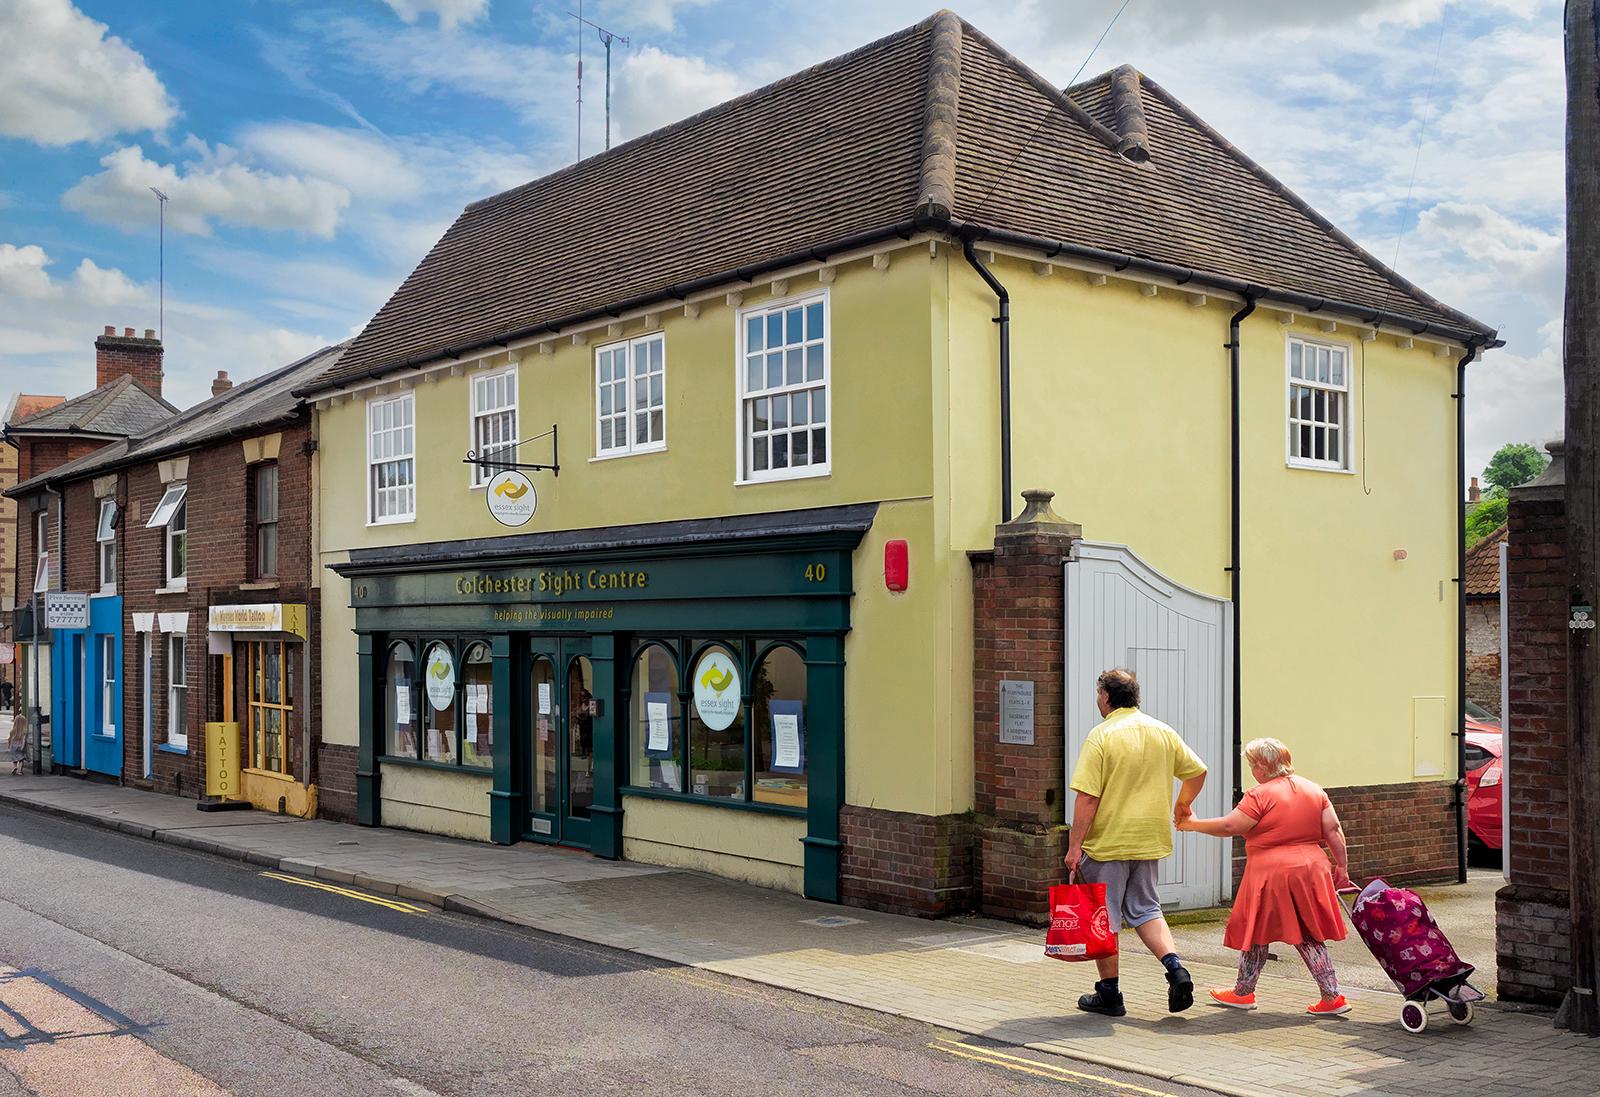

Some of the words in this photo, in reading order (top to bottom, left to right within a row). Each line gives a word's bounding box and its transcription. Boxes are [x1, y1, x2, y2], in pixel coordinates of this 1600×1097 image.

[804, 563, 825, 581] 40
[456, 575, 532, 594] Colchester
[539, 572, 582, 595] Sight
[588, 570, 647, 590] Centre
[249, 609, 265, 621] Tattoo
[494, 611, 522, 622] helping
[525, 610, 537, 620] the
[540, 609, 572, 621] visually
[574, 608, 613, 621] impaired
[701, 700, 717, 708] essex
[718, 699, 734, 710] sight
[219, 725, 228, 790] TATTOO
